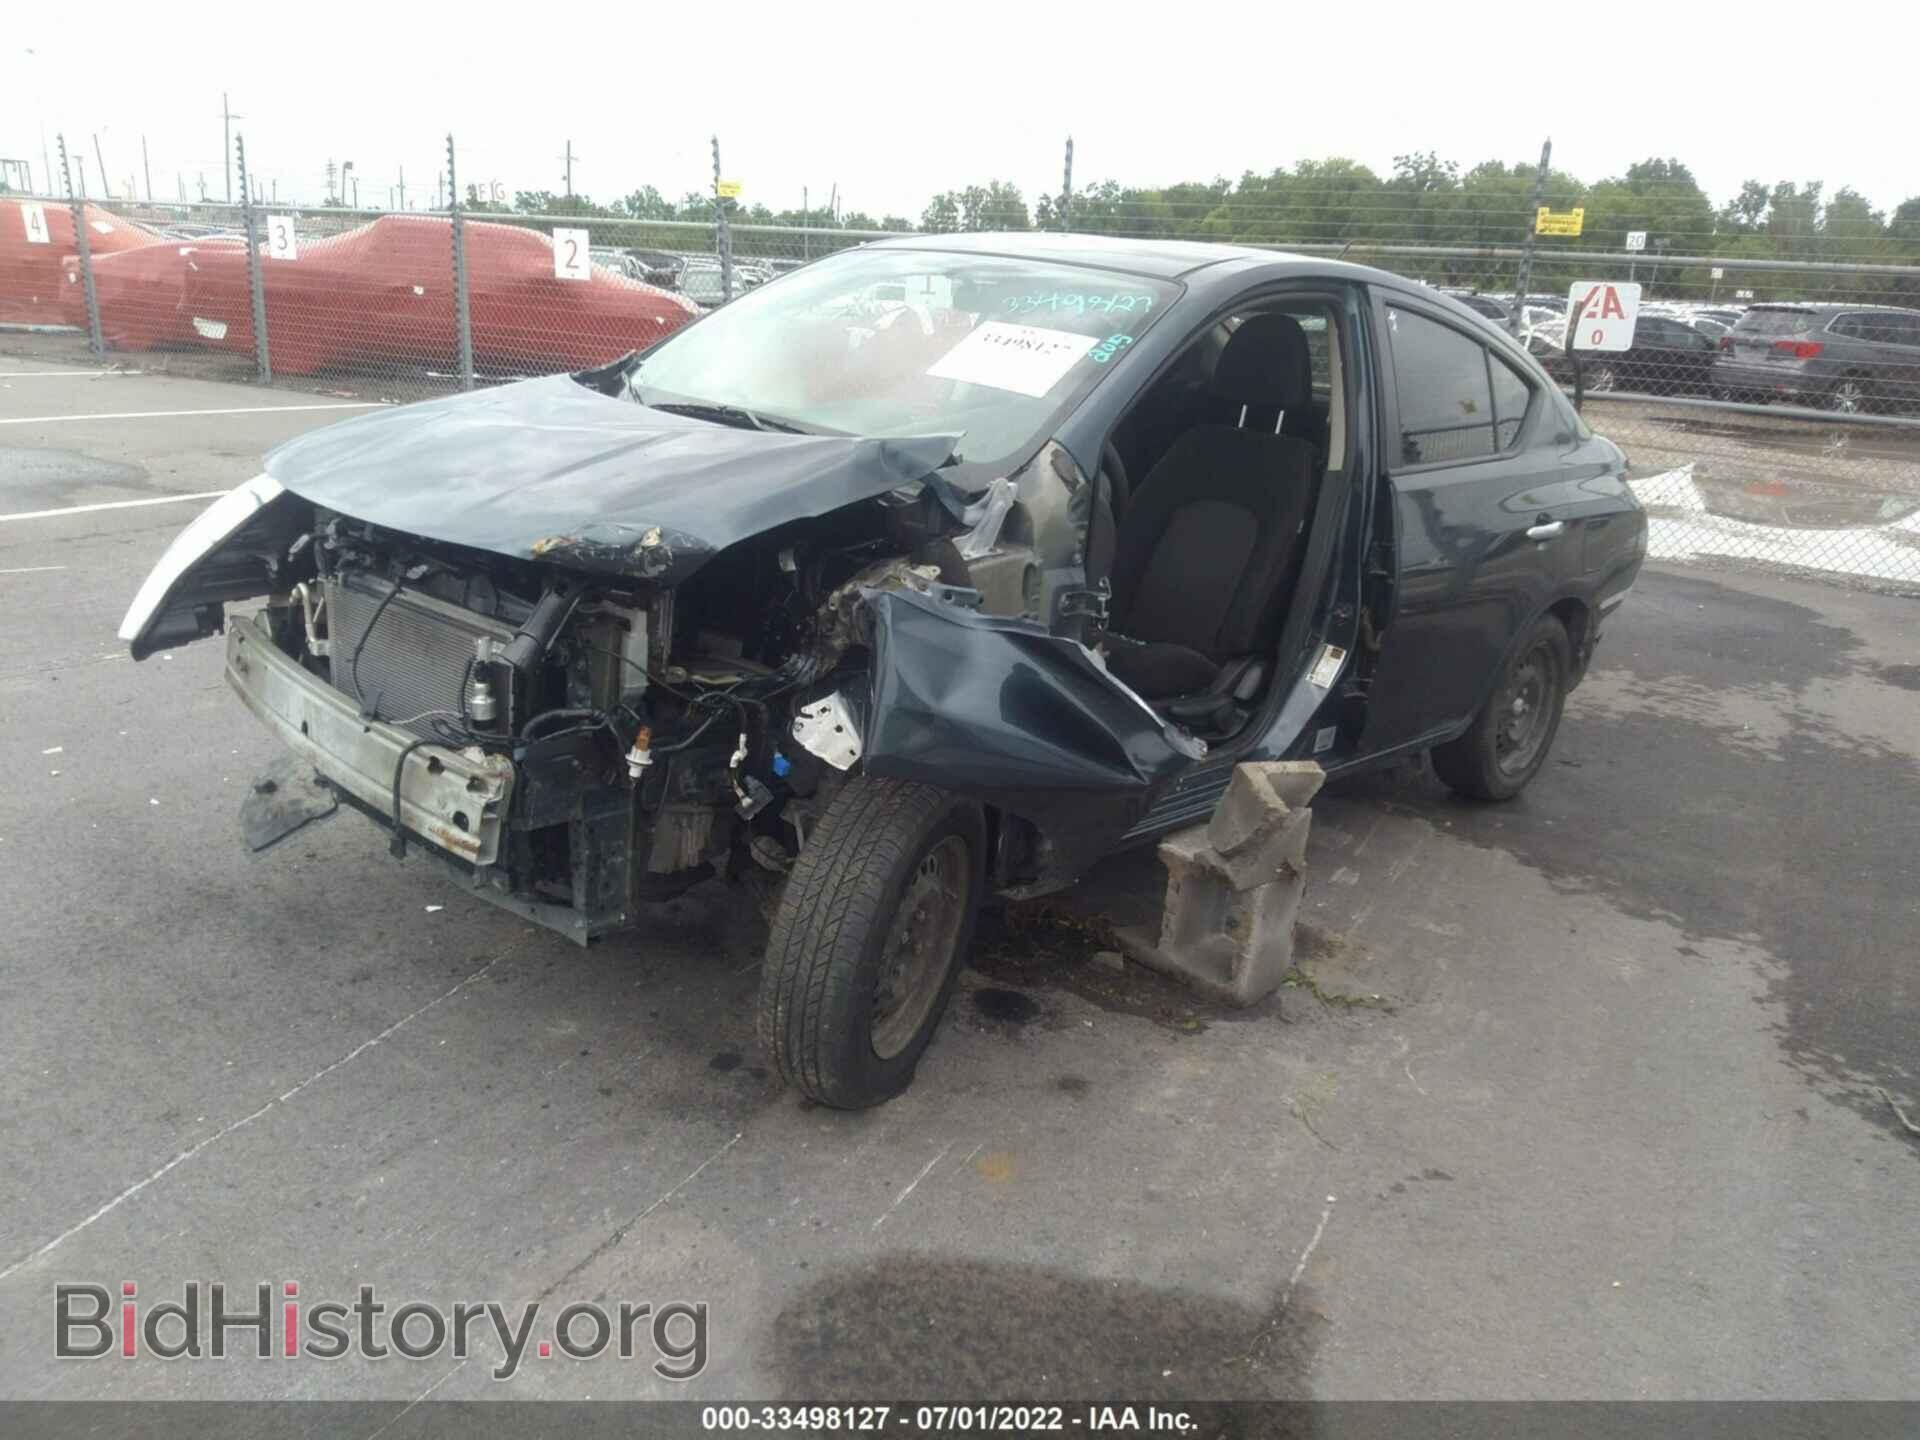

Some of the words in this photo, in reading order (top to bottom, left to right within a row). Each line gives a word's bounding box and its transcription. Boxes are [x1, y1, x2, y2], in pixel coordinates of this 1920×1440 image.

[31, 211, 41, 234] 4
[276, 224, 288, 250] 3
[564, 239, 580, 269] 2
[1591, 329, 1604, 345] 0
